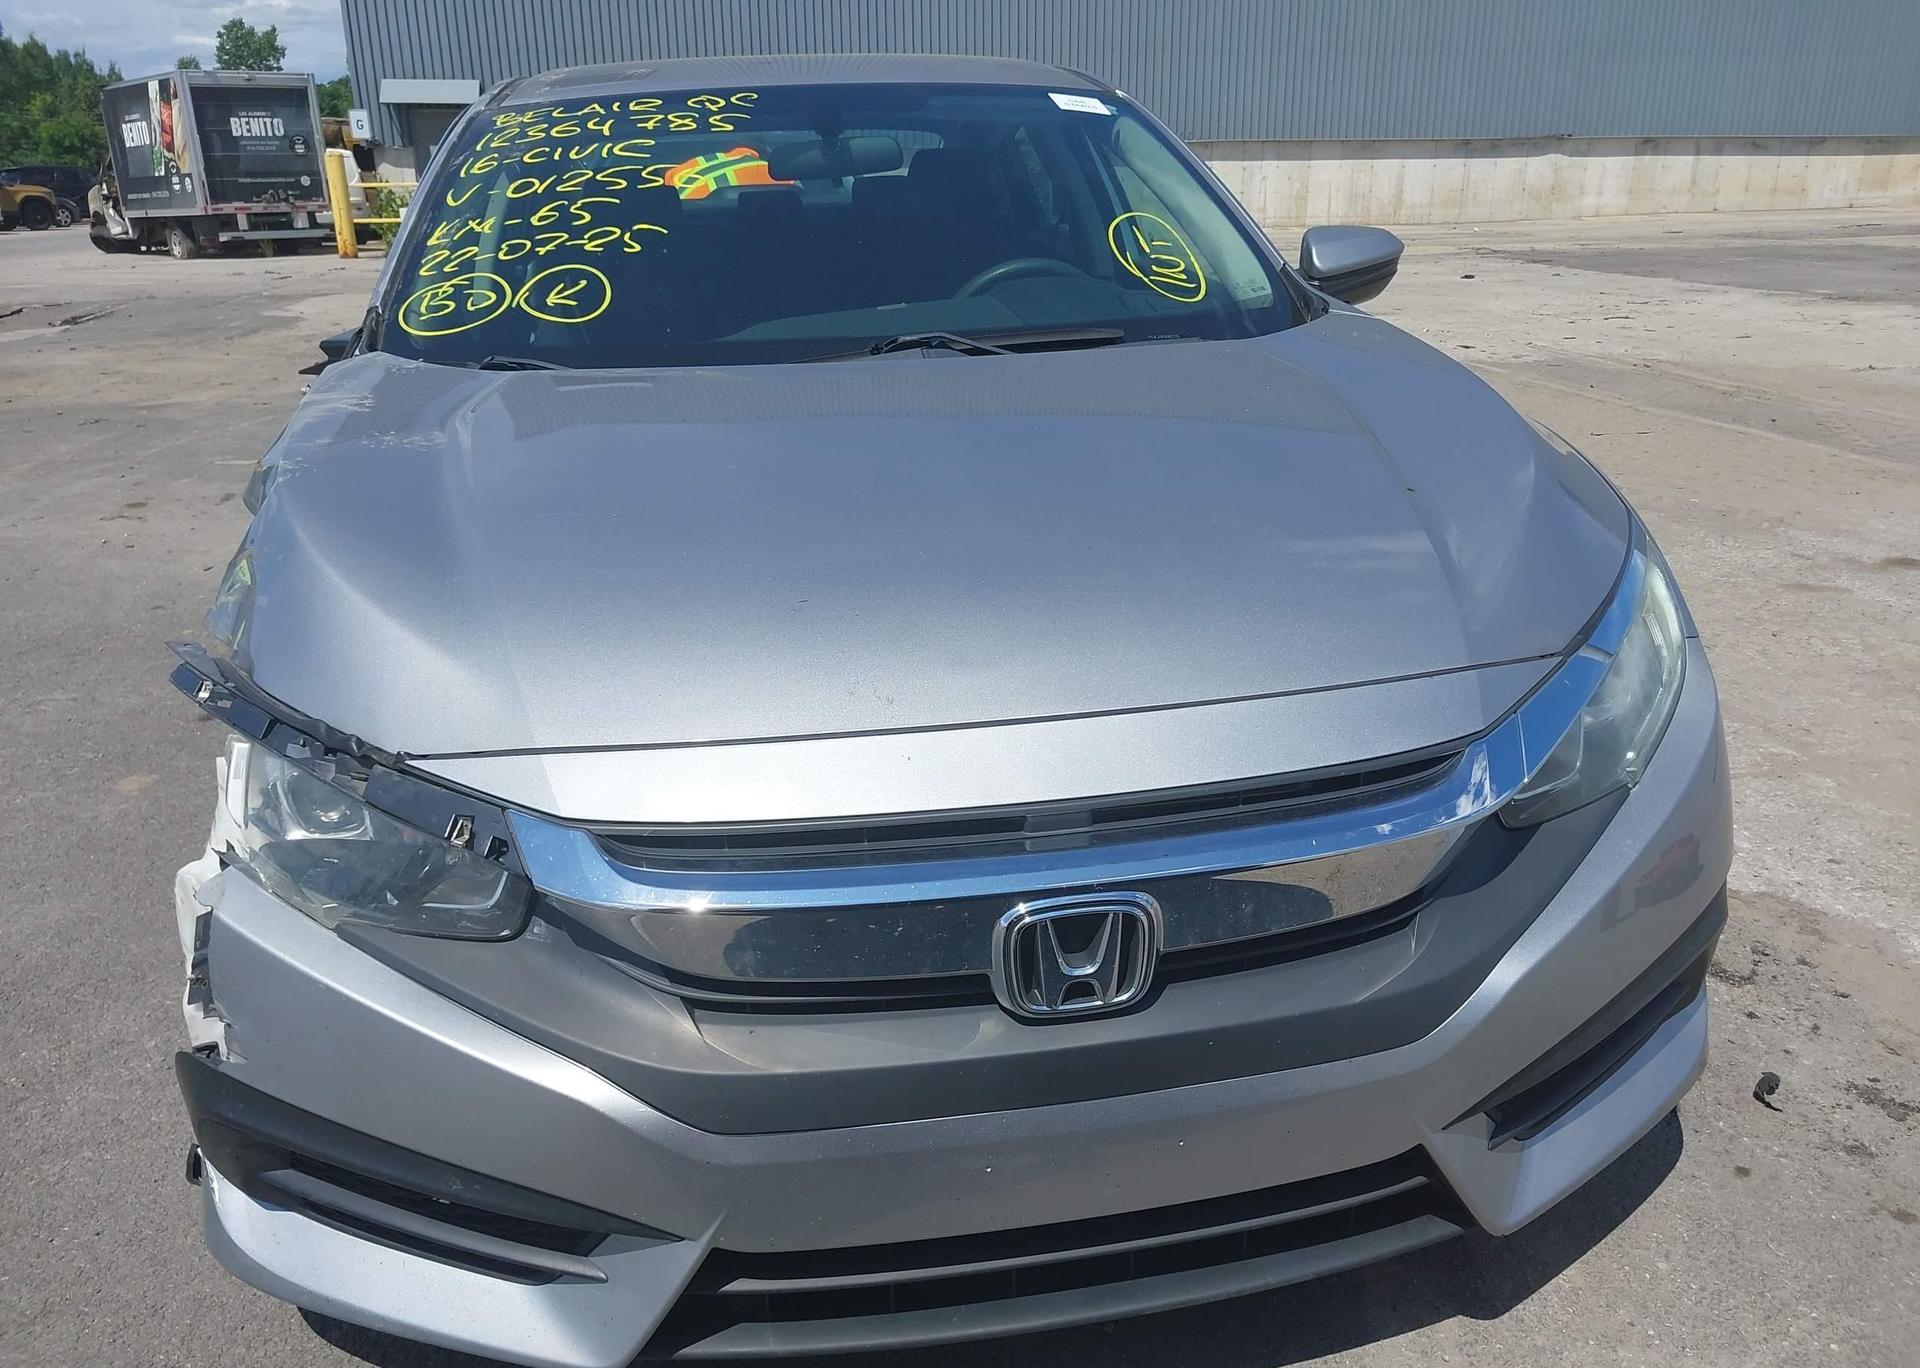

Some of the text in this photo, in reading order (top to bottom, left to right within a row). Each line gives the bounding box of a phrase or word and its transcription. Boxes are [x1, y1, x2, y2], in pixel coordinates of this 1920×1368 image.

[122, 120, 150, 148] BENITO
[230, 117, 285, 137] BENITO
[356, 119, 365, 130] G
